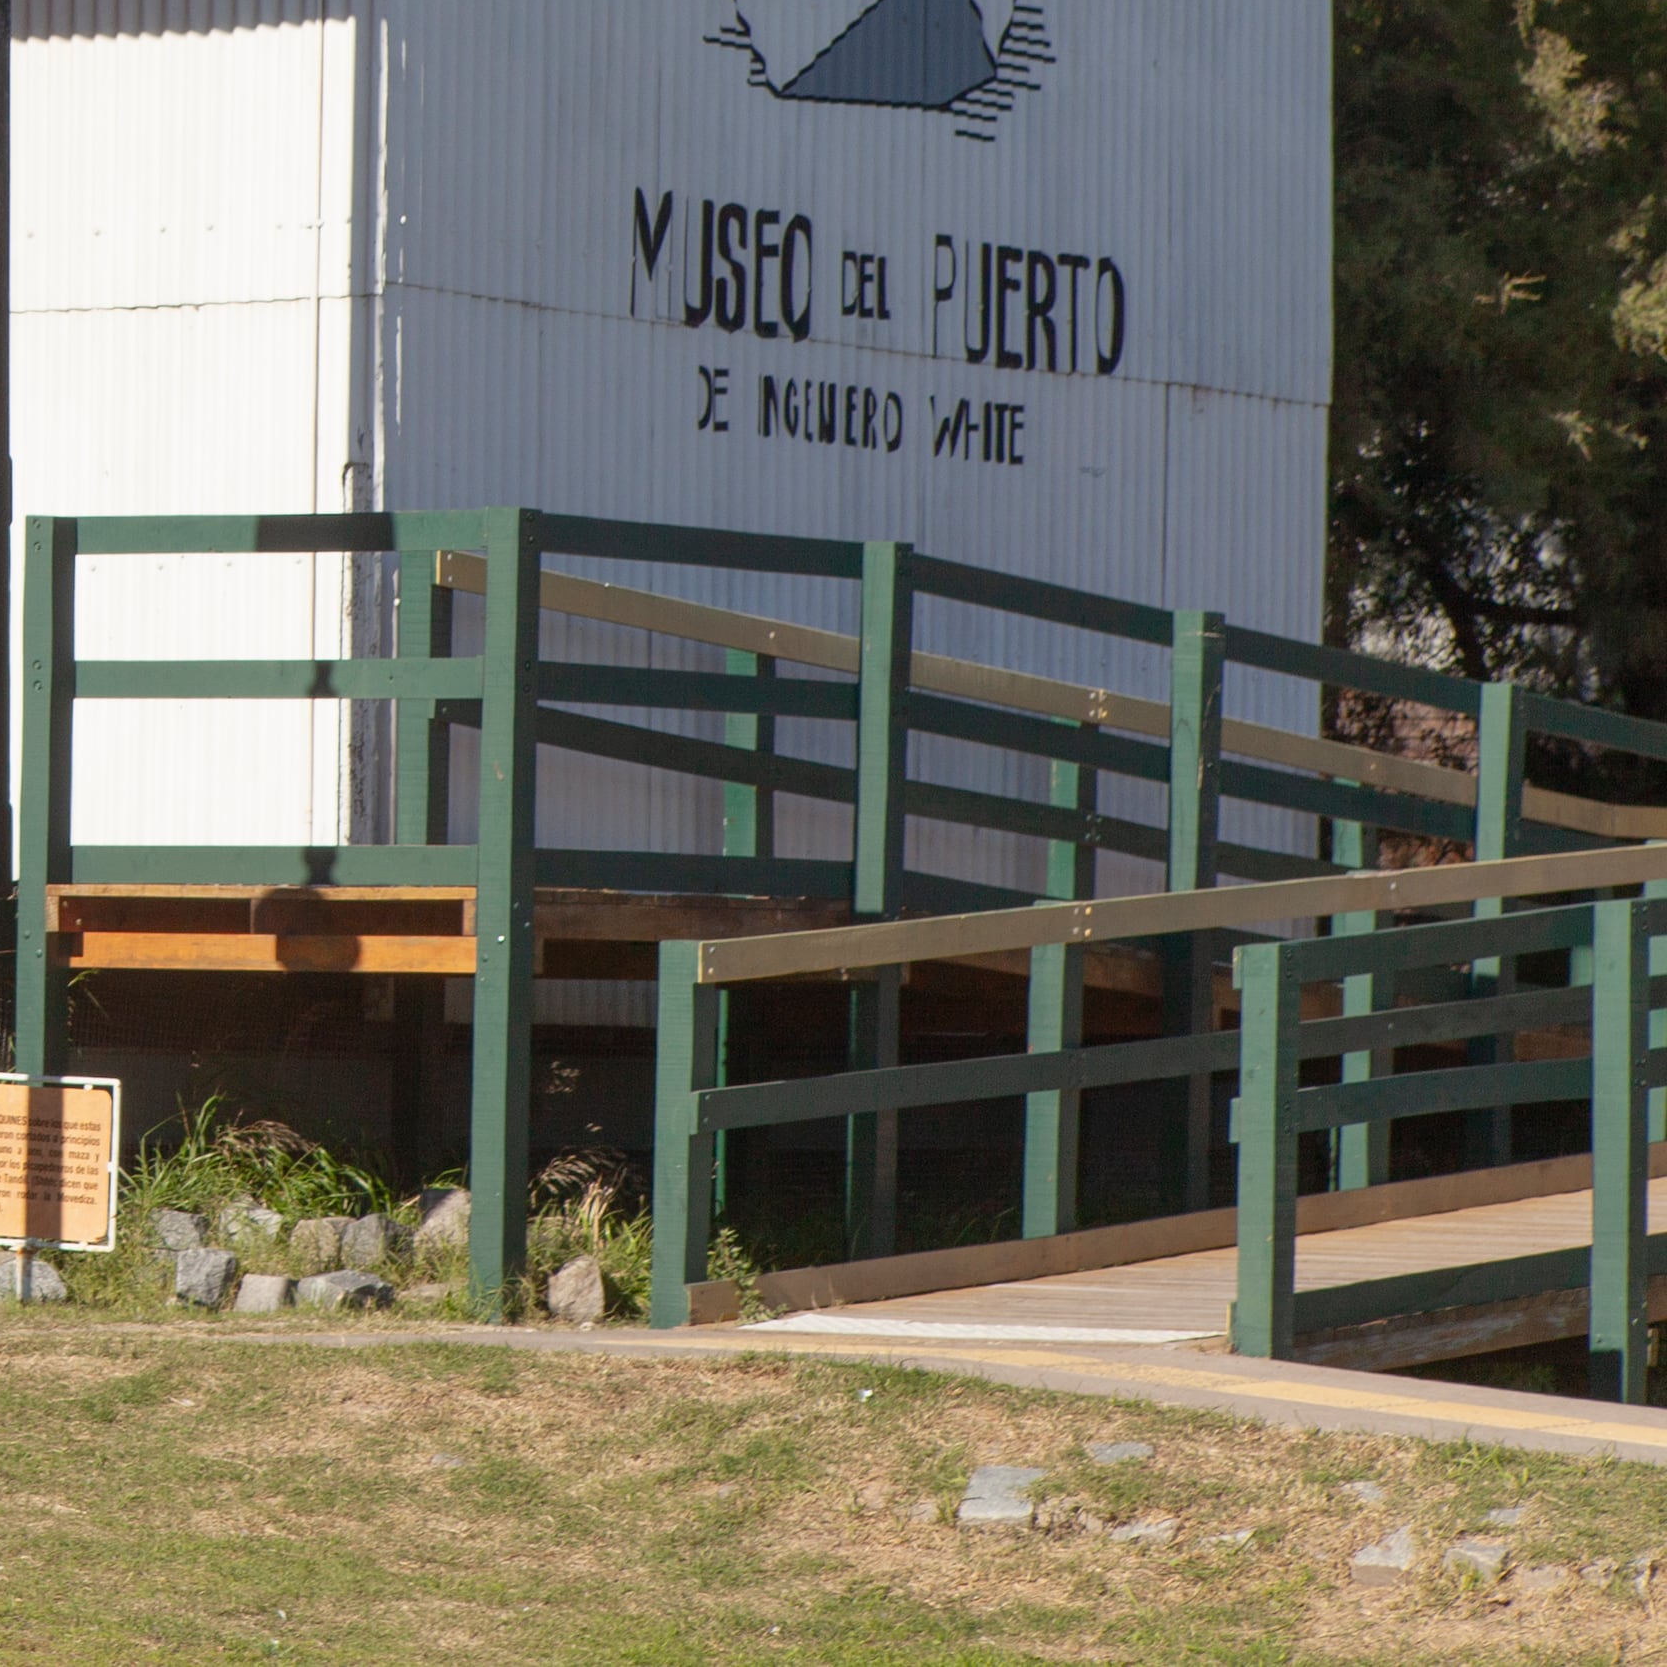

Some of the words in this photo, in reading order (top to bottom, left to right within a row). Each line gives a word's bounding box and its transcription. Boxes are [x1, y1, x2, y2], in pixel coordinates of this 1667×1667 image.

[630, 187, 813, 343] MUSEO
[841, 250, 891, 321] DEL
[934, 234, 1125, 376] PUERTO
[697, 365, 730, 432] DE
[758, 374, 903, 453] INGENIERO
[930, 395, 1025, 465] WHITE
[62, 1120, 79, 1131] que
[60, 1135, 101, 1147] principios
[17, 1147, 22, 1155] a
[69, 1150, 90, 1160] maza
[95, 1154, 100, 1163] y
[76, 1165, 85, 1175] de
[87, 1166, 99, 1176] las
[83, 1181, 98, 1191] que
